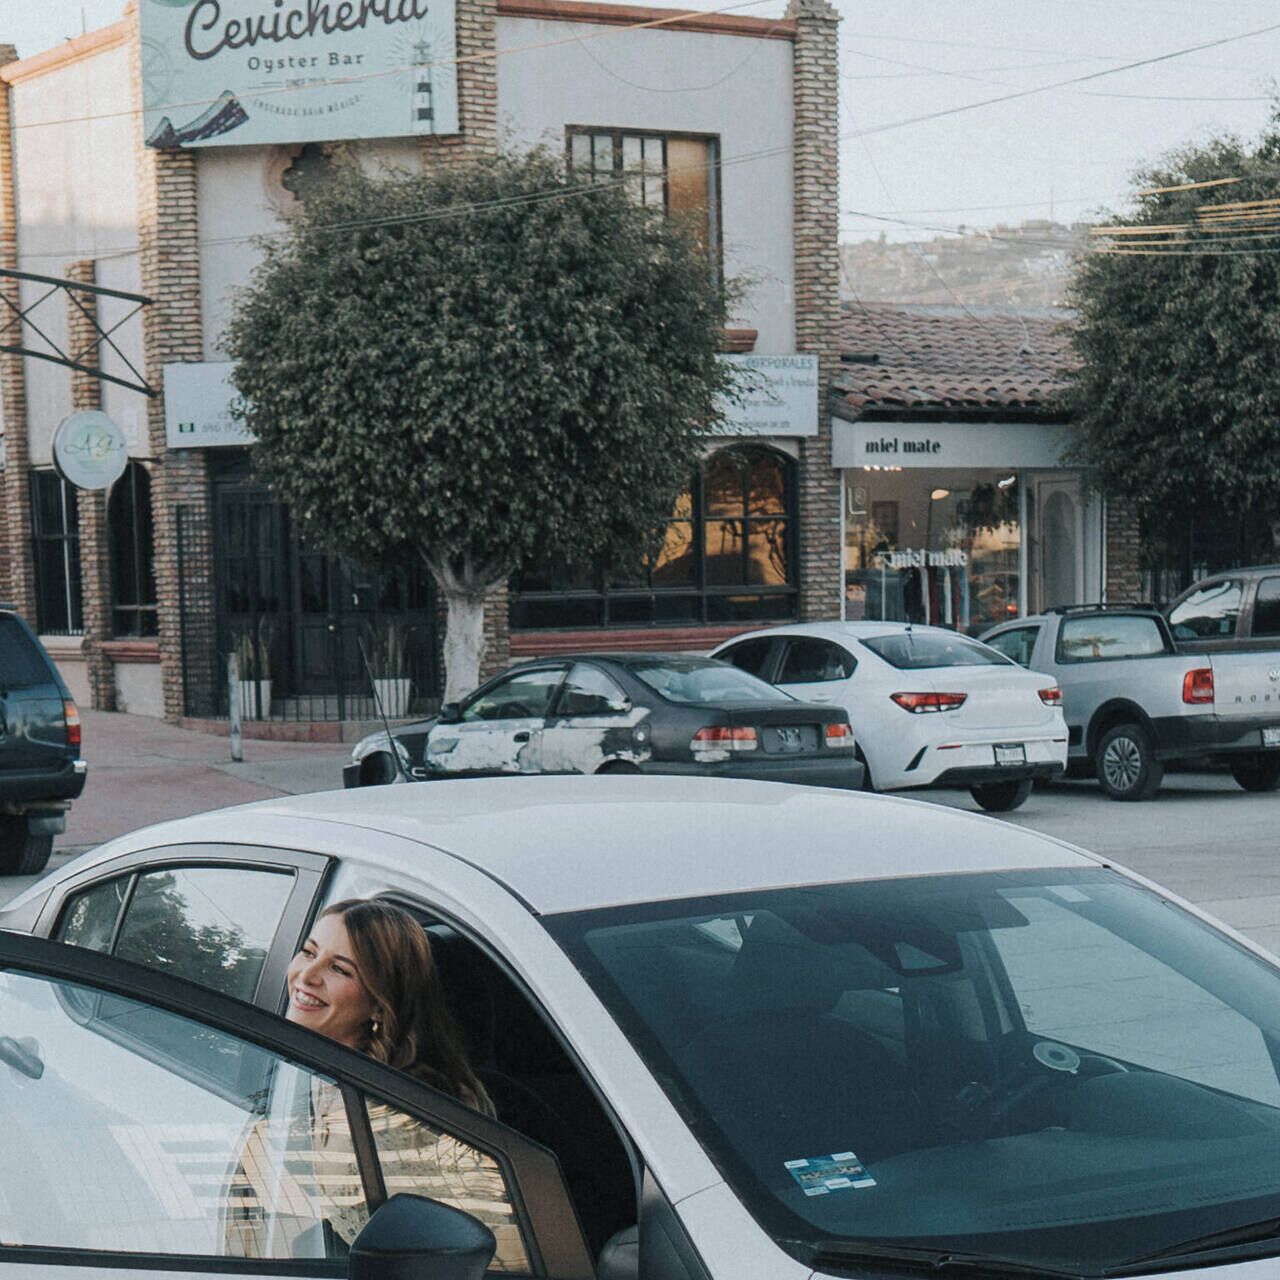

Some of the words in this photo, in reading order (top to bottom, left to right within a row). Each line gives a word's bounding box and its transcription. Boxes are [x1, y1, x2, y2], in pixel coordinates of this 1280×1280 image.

[248, 54, 317, 74] Oyster
[328, 51, 365, 67] Bar
[865, 437, 898, 453] miel
[903, 439, 941, 453] mate
[890, 548, 926, 568] miel
[929, 549, 968, 567] mate
